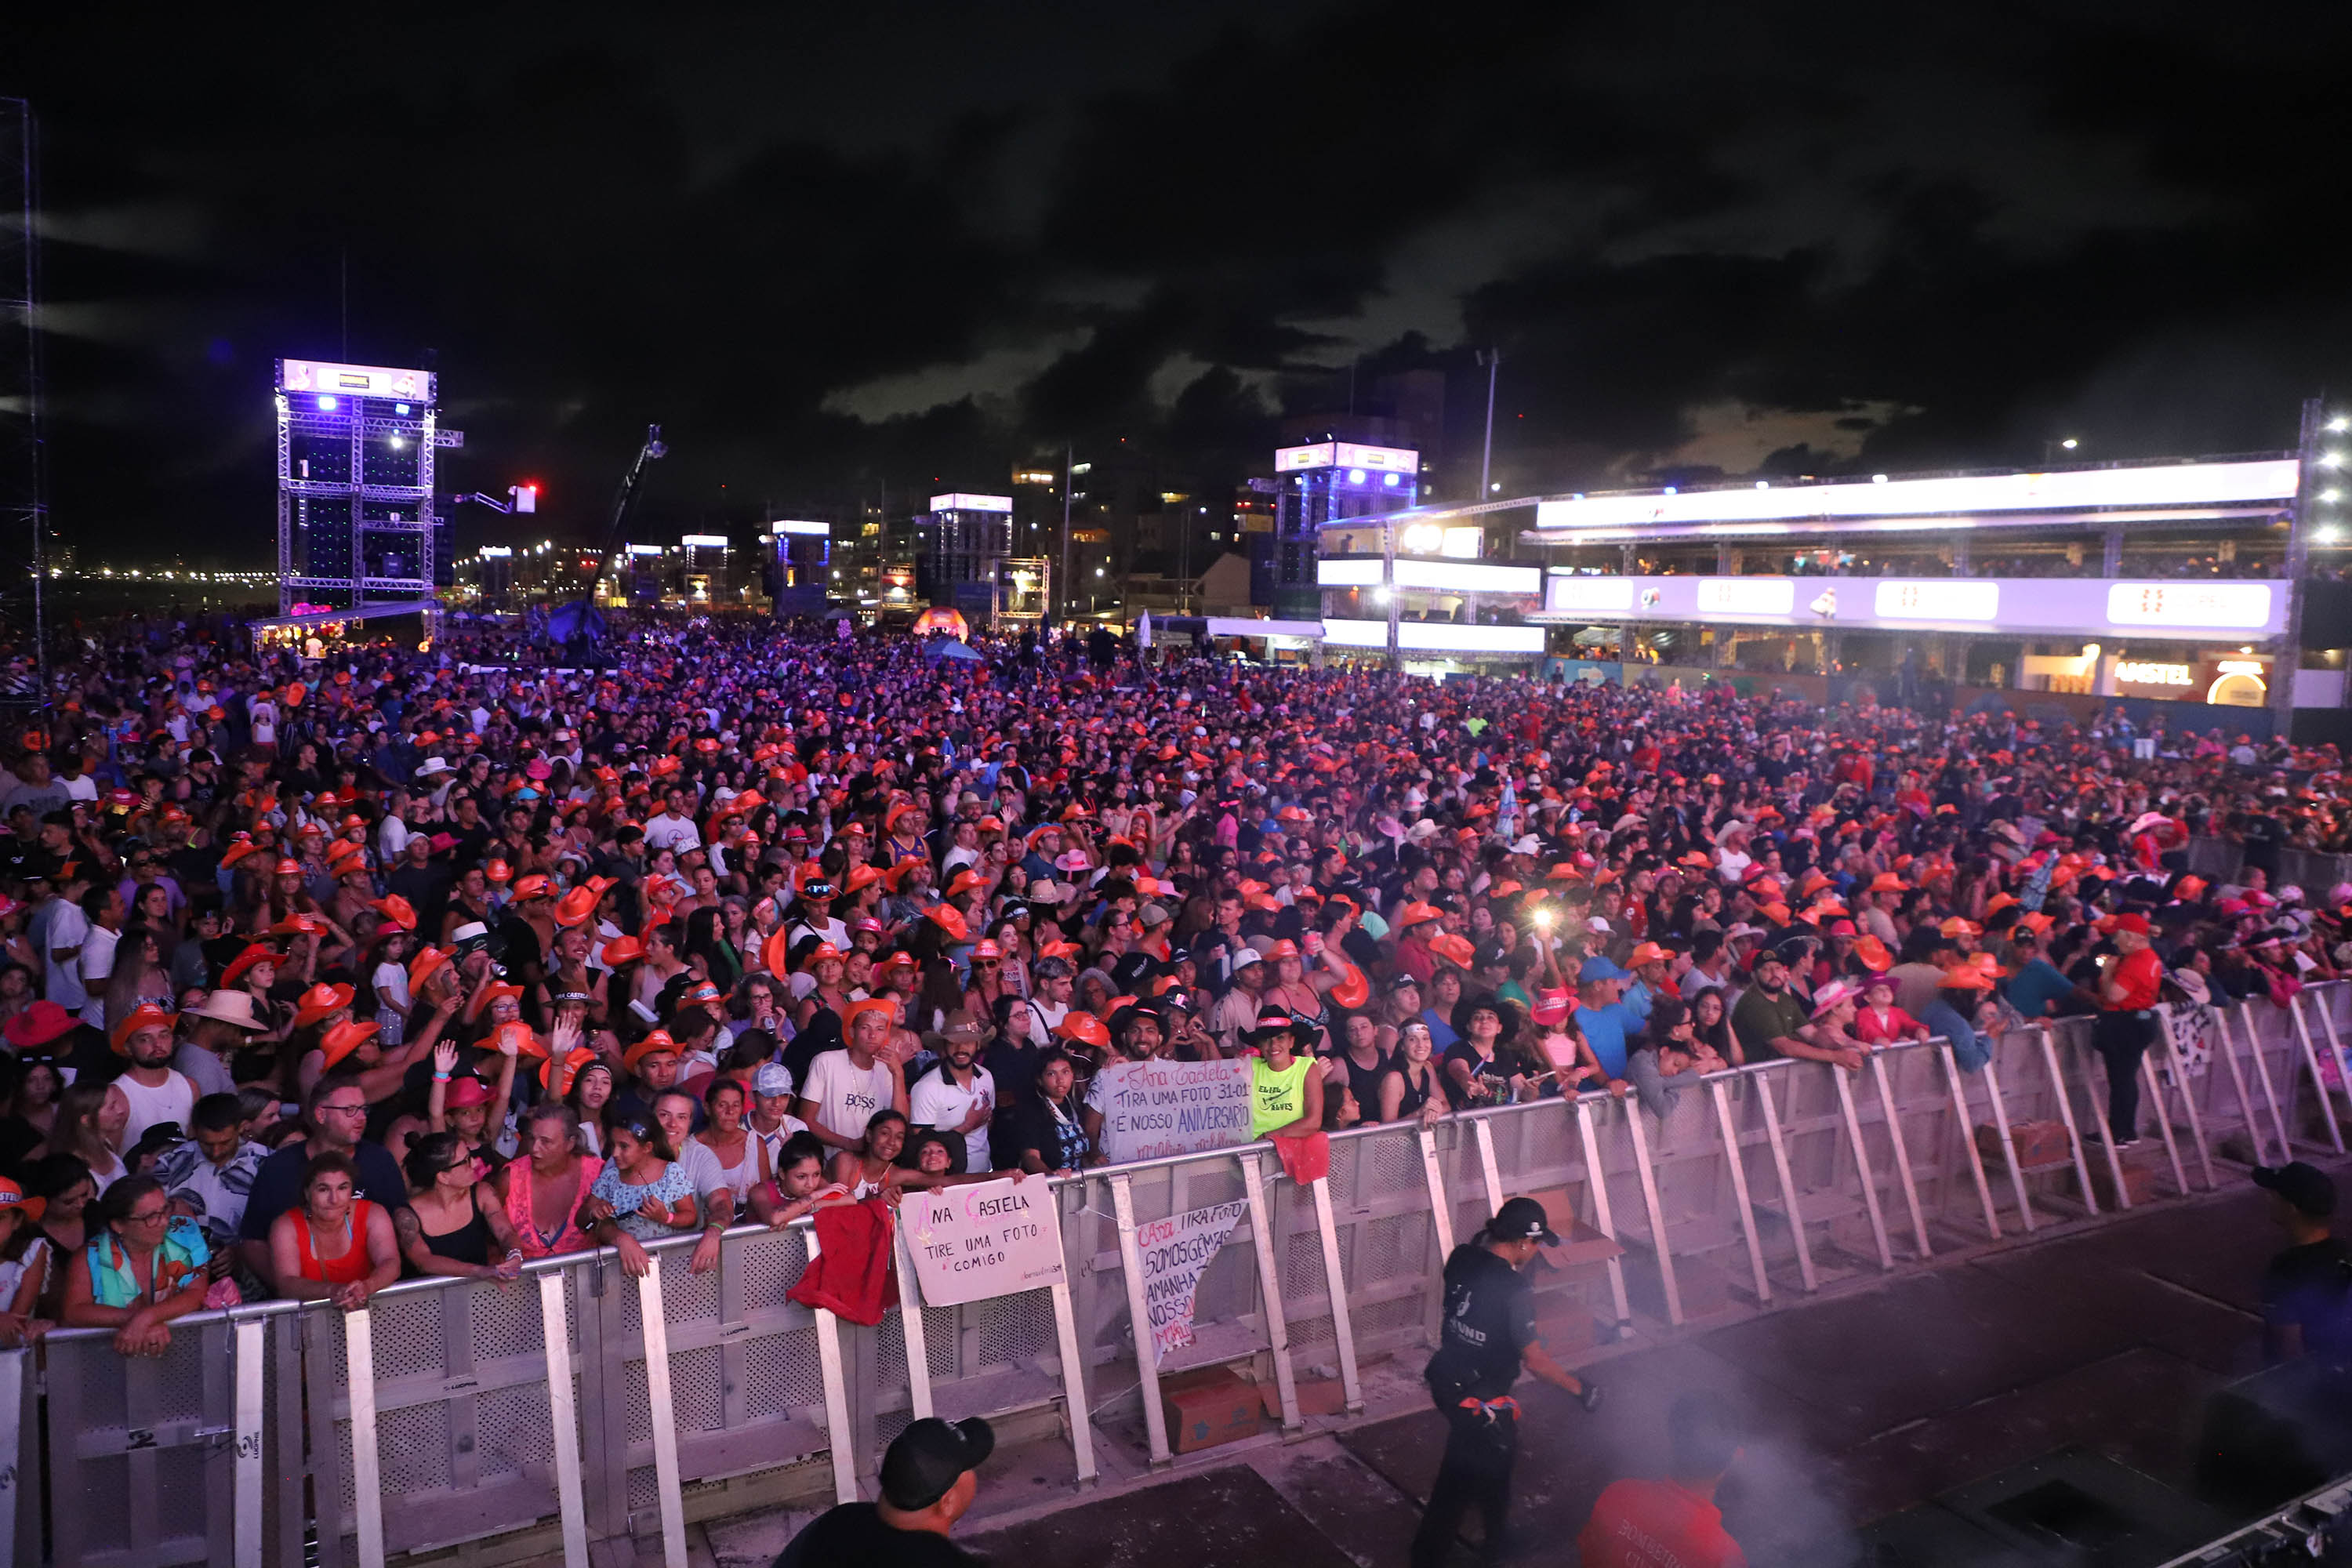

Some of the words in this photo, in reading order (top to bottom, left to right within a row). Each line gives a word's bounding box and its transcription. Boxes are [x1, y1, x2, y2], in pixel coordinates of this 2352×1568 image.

[2114, 662, 2193, 685] AMSTEL
[1127, 1062, 1168, 1090] Ana
[1171, 1062, 1230, 1086] Castela
[844, 1093, 875, 1110] BOSS
[1114, 1090, 1146, 1109] TIRA
[1152, 1088, 1178, 1105] UMA
[1181, 1086, 1211, 1103] FOTO
[1217, 1083, 1249, 1099] 31-01
[1271, 1102, 1293, 1111] ALVES
[1116, 1111, 1126, 1132] É
[1131, 1114, 1173, 1131] NOSSO
[914, 1196, 953, 1234] ANA
[965, 1189, 1029, 1217] CASTELA
[925, 1243, 954, 1260] TIRE
[965, 1235, 992, 1251] UMA
[1003, 1224, 1037, 1243] FOTO
[954, 1251, 1005, 1272] COMIGO
